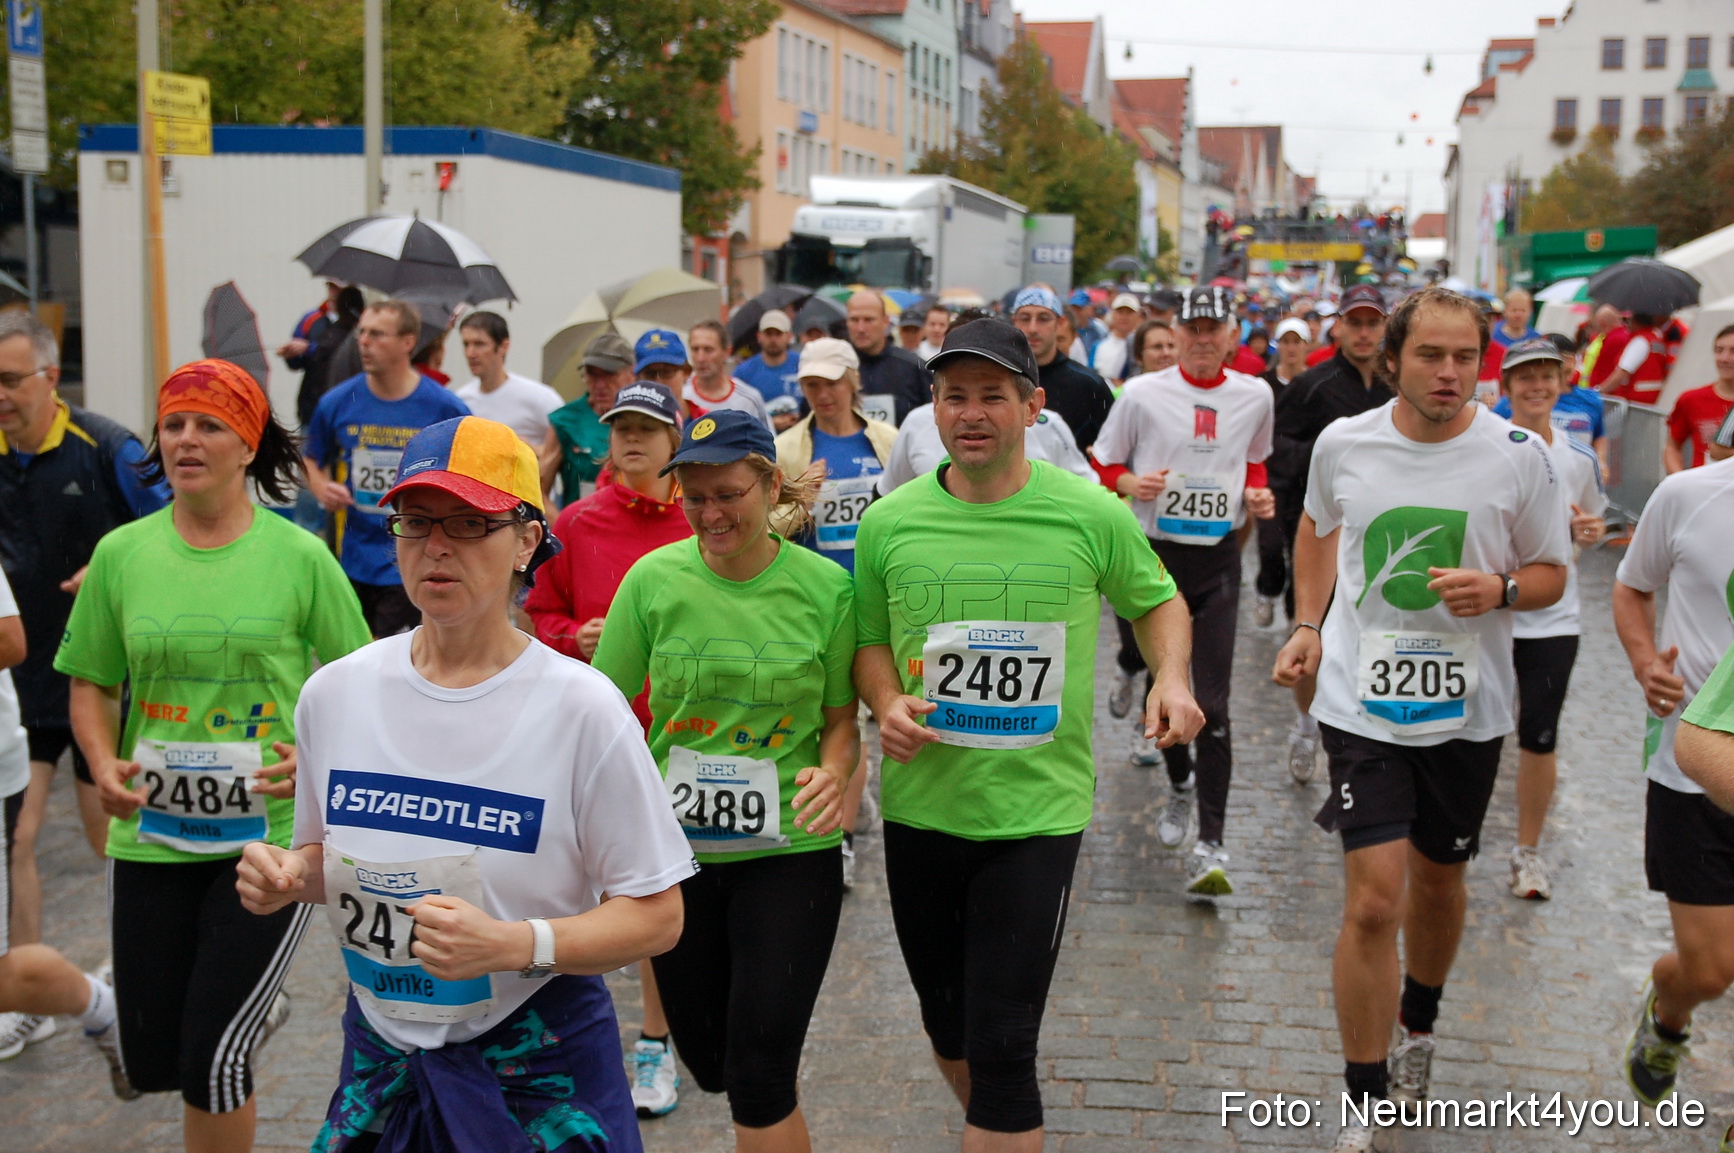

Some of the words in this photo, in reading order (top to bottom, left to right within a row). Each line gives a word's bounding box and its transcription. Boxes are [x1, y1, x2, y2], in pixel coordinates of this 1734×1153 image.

[1165, 490, 1228, 518] 2458
[968, 628, 1024, 643] BOCK
[938, 652, 1052, 703] 2487
[1370, 659, 1466, 698] 3205
[945, 708, 1037, 731] Sommerer
[144, 770, 252, 815] 2484
[346, 788, 521, 837] STAEDTLER
[672, 782, 766, 834] 2489
[179, 821, 221, 838] Anita
[355, 867, 419, 889] BOCK
[372, 969, 433, 998] Ulrike
